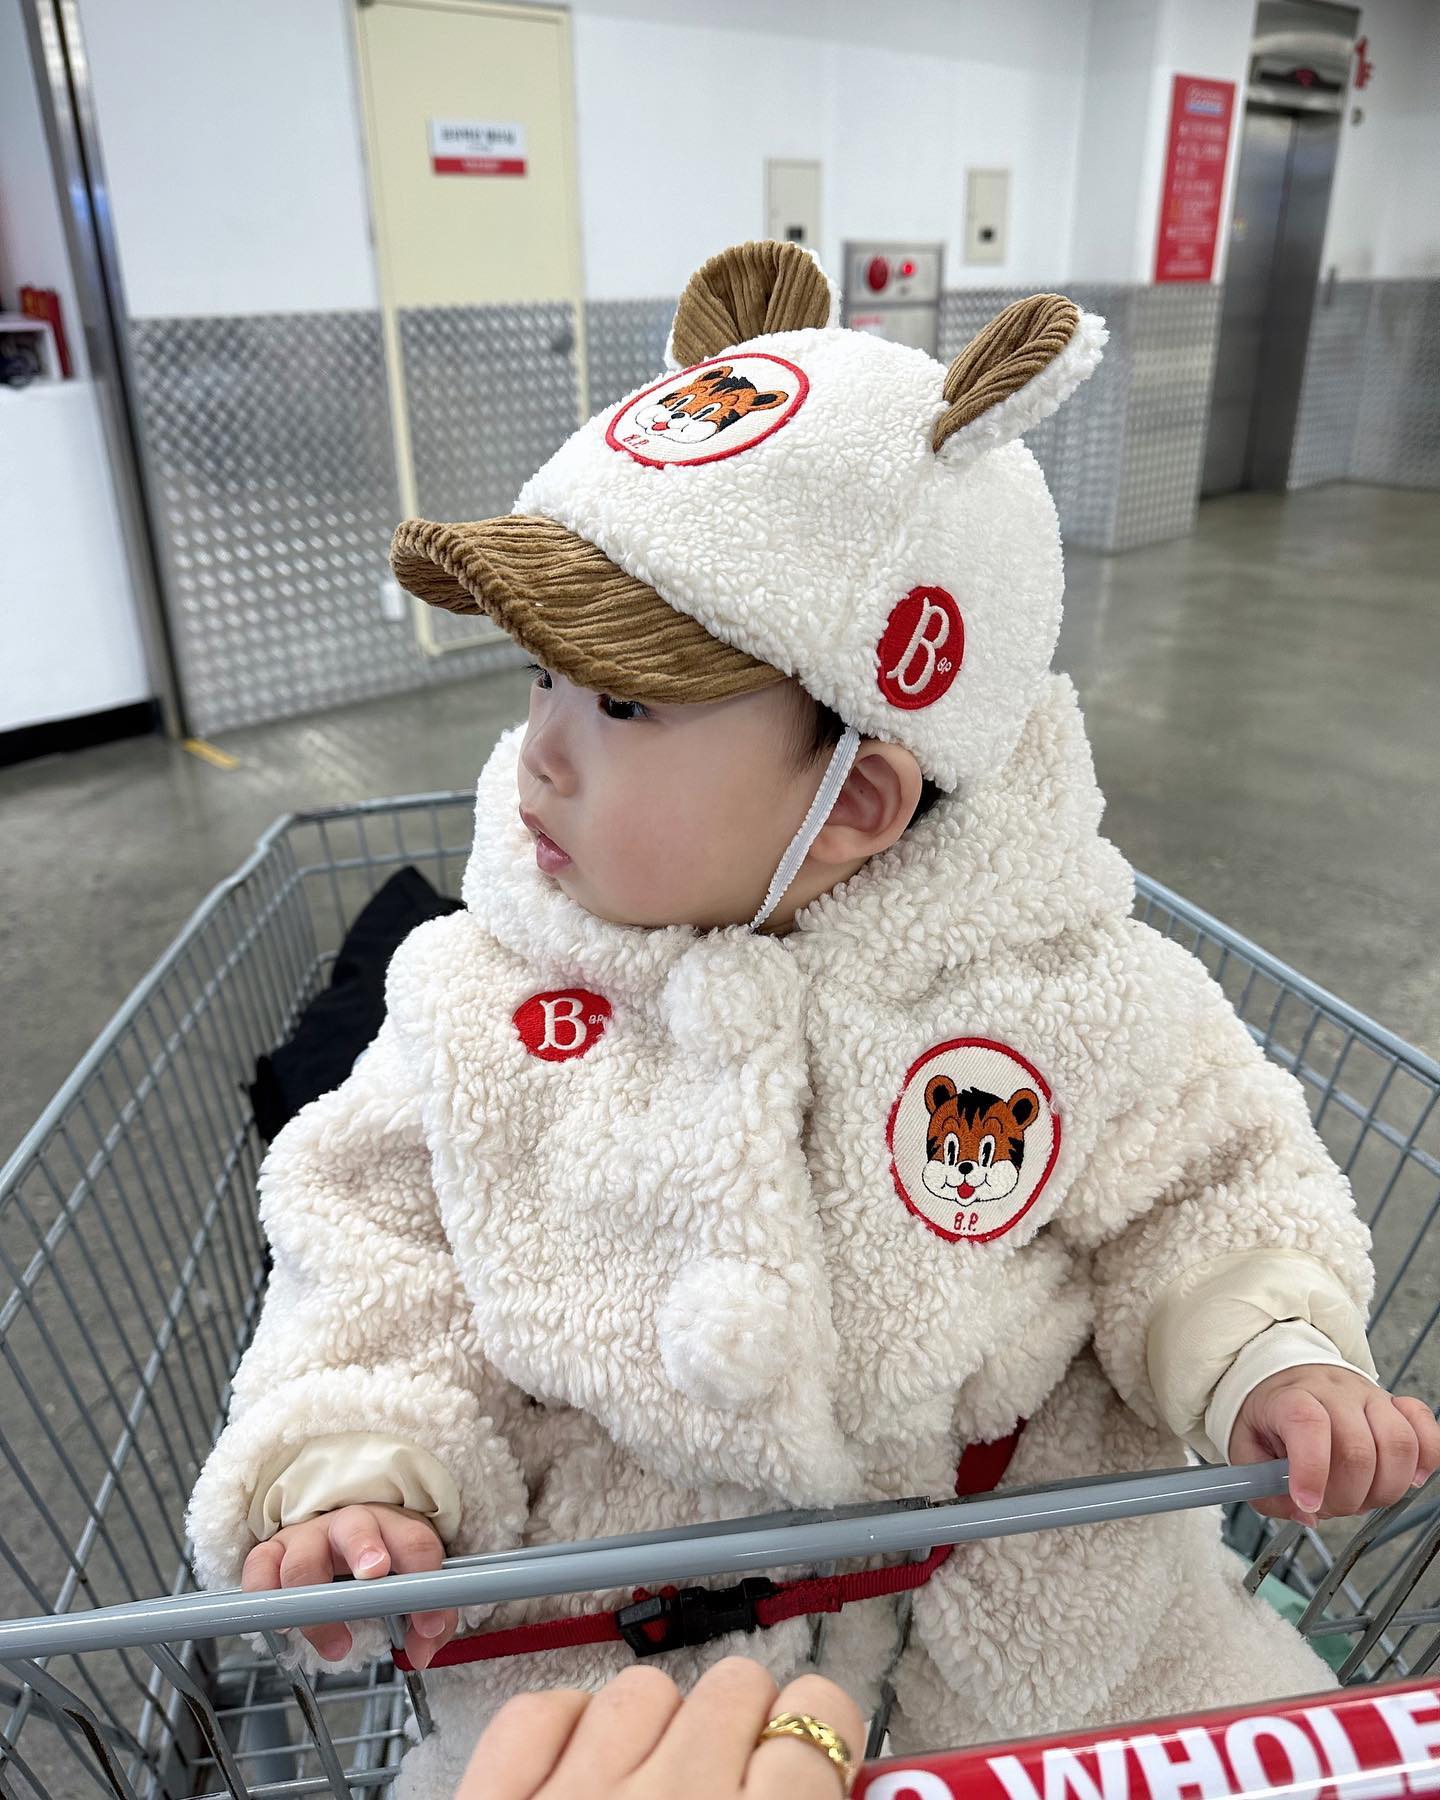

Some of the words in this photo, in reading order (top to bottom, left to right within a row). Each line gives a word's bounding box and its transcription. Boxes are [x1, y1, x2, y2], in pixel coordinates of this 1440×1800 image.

[886, 596, 950, 695] B
[537, 997, 587, 1051] B
[953, 1211, 979, 1232] B.P.
